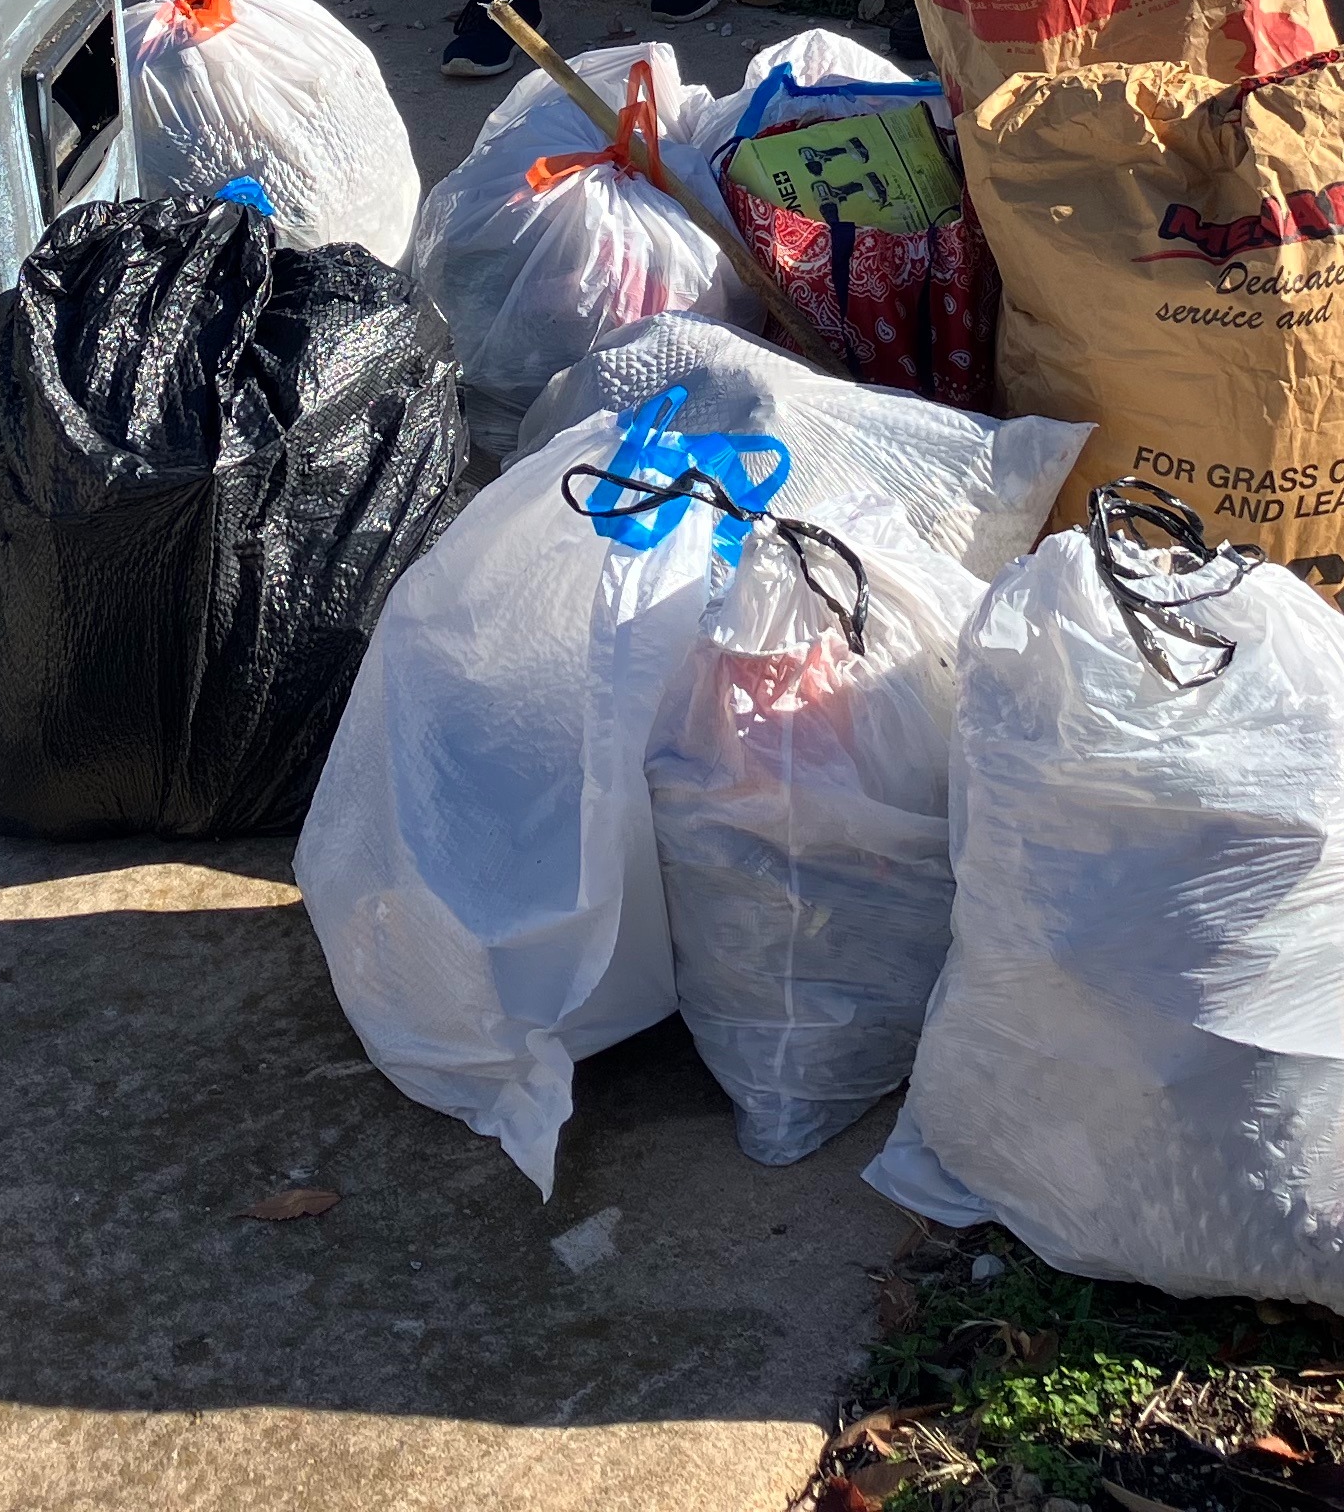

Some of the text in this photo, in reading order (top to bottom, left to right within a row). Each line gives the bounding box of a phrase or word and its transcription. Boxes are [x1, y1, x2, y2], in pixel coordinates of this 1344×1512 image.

[1155, 301, 1265, 331] service
[1275, 296, 1334, 331] and
[1133, 445, 1197, 484] FOR
[1206, 463, 1319, 495] GRASS
[1214, 493, 1285, 524] AND
